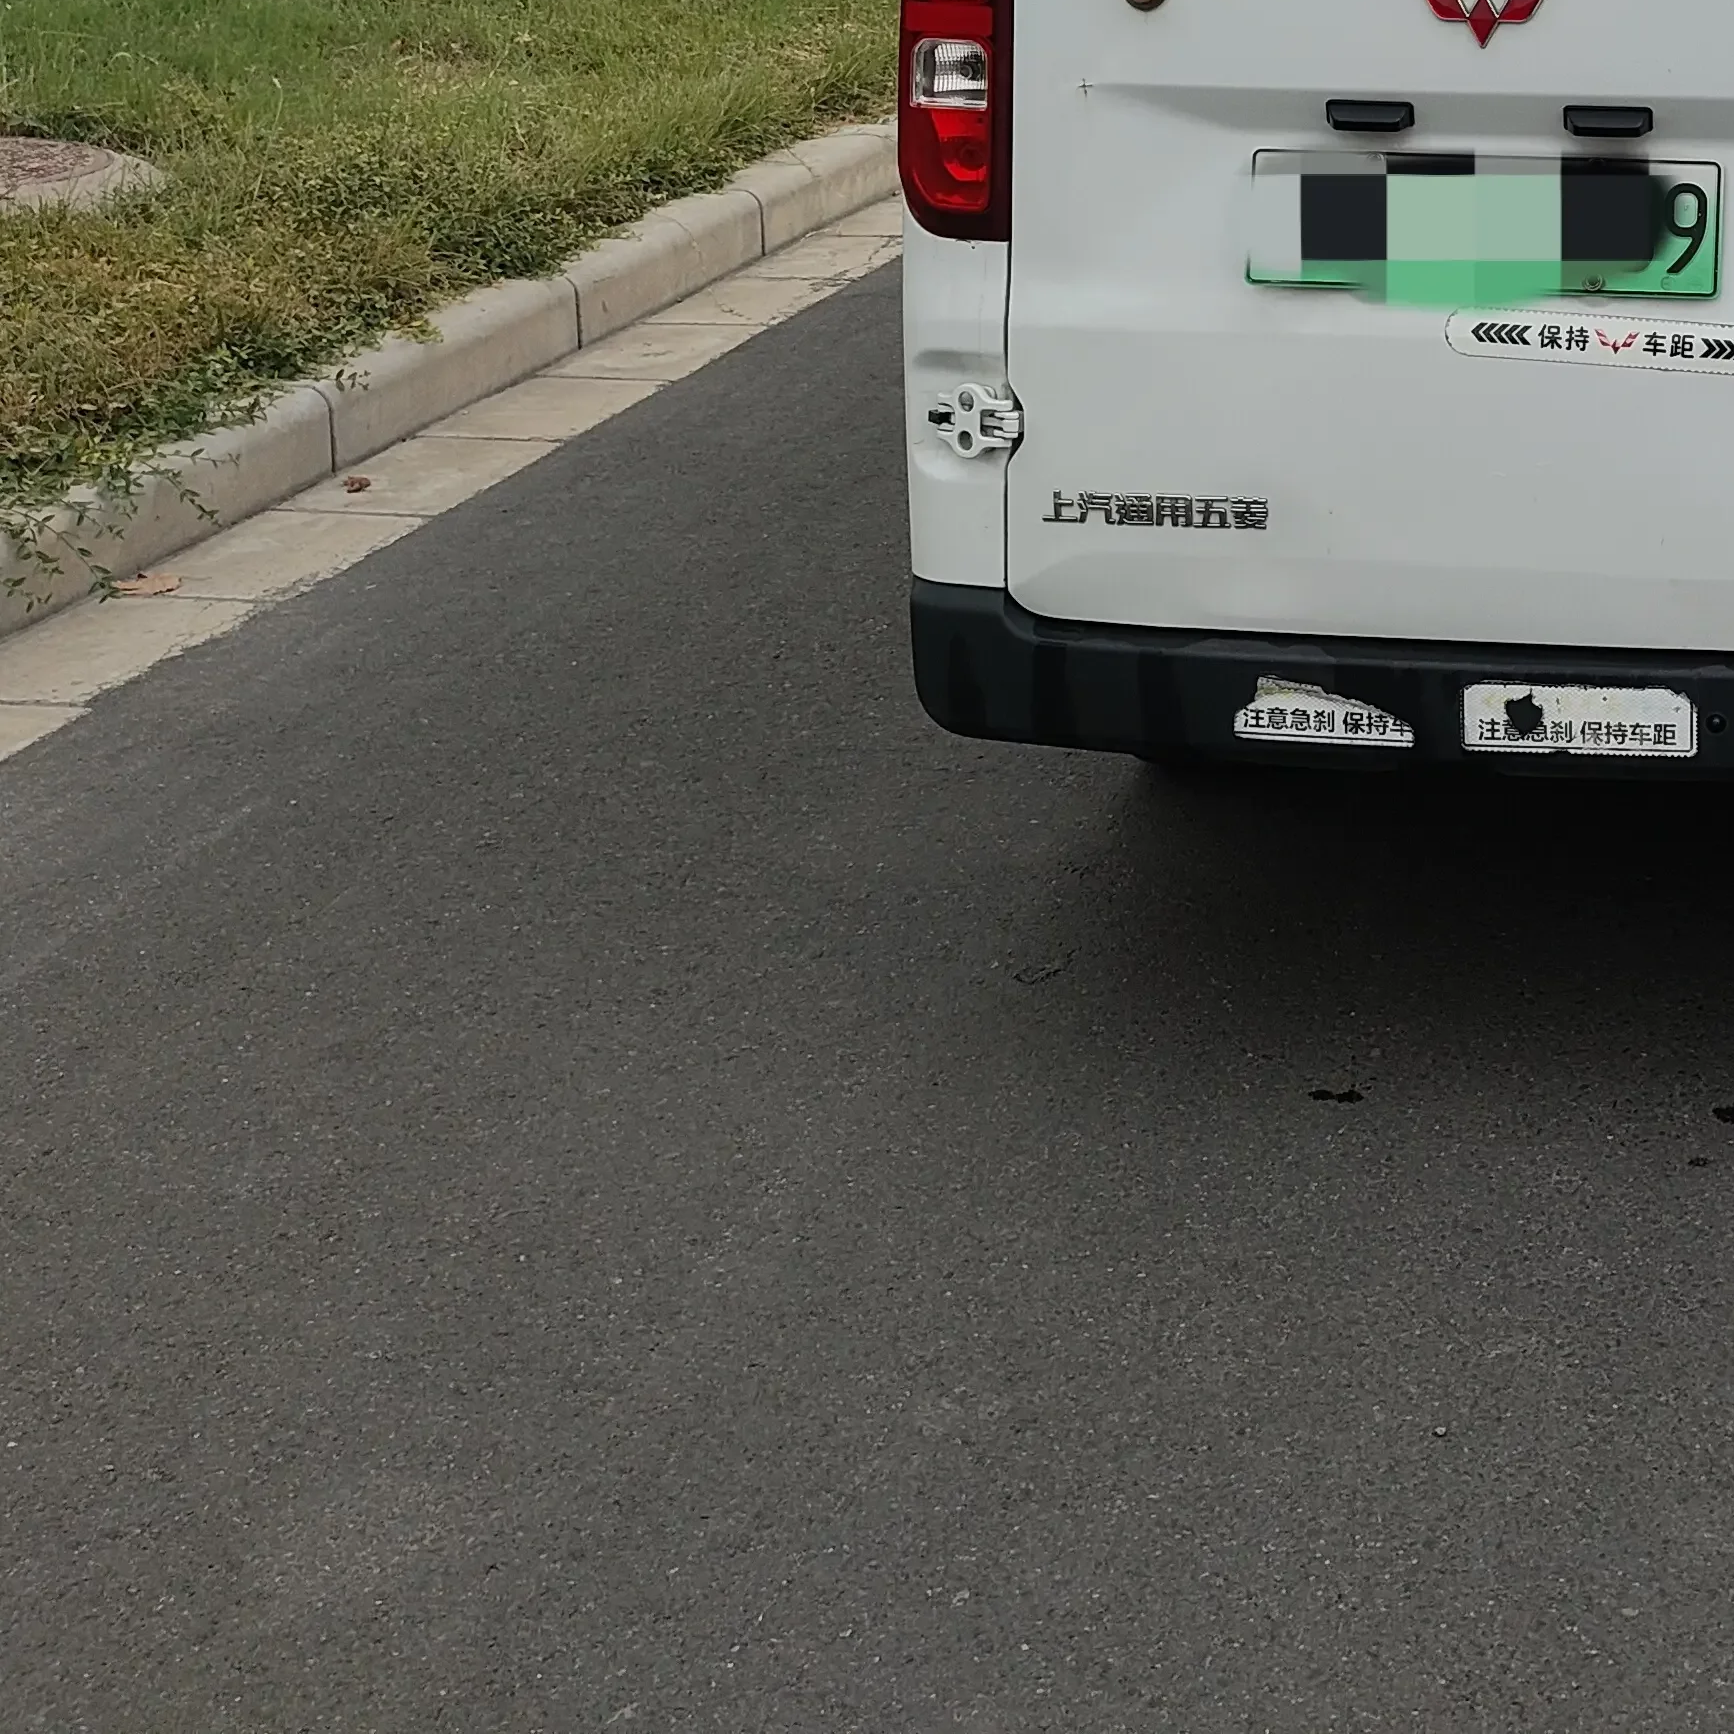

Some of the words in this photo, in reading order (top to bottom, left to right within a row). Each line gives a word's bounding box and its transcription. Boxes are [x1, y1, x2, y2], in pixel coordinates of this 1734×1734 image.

[1538, 324, 1590, 352] 保持
[1642, 332, 1695, 360] 车距
[1042, 489, 1268, 530] 上汽通用五菱
[1243, 707, 1335, 733] 注意急刹
[1580, 721, 1677, 746] 保持车距
